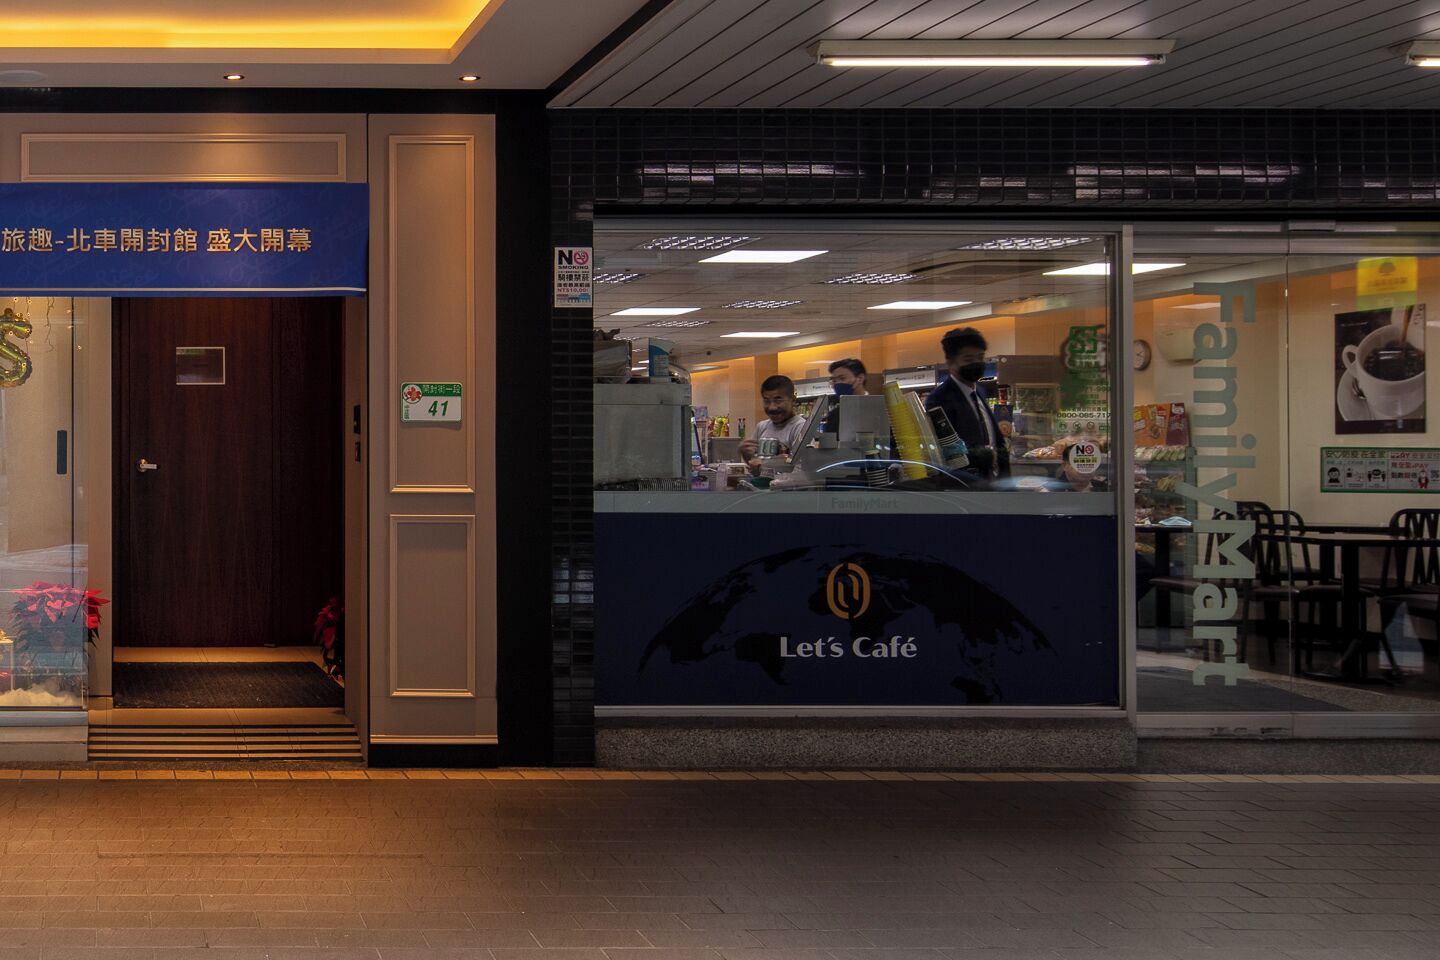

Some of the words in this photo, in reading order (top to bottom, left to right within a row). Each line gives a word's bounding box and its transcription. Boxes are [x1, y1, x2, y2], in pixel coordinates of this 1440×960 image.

[206, 227, 312, 253] 盛大開幕
[427, 400, 449, 417] 41
[1176, 282, 1257, 686] FamilyMart
[831, 497, 899, 512] FamilyMart
[852, 636, 918, 658] Café
